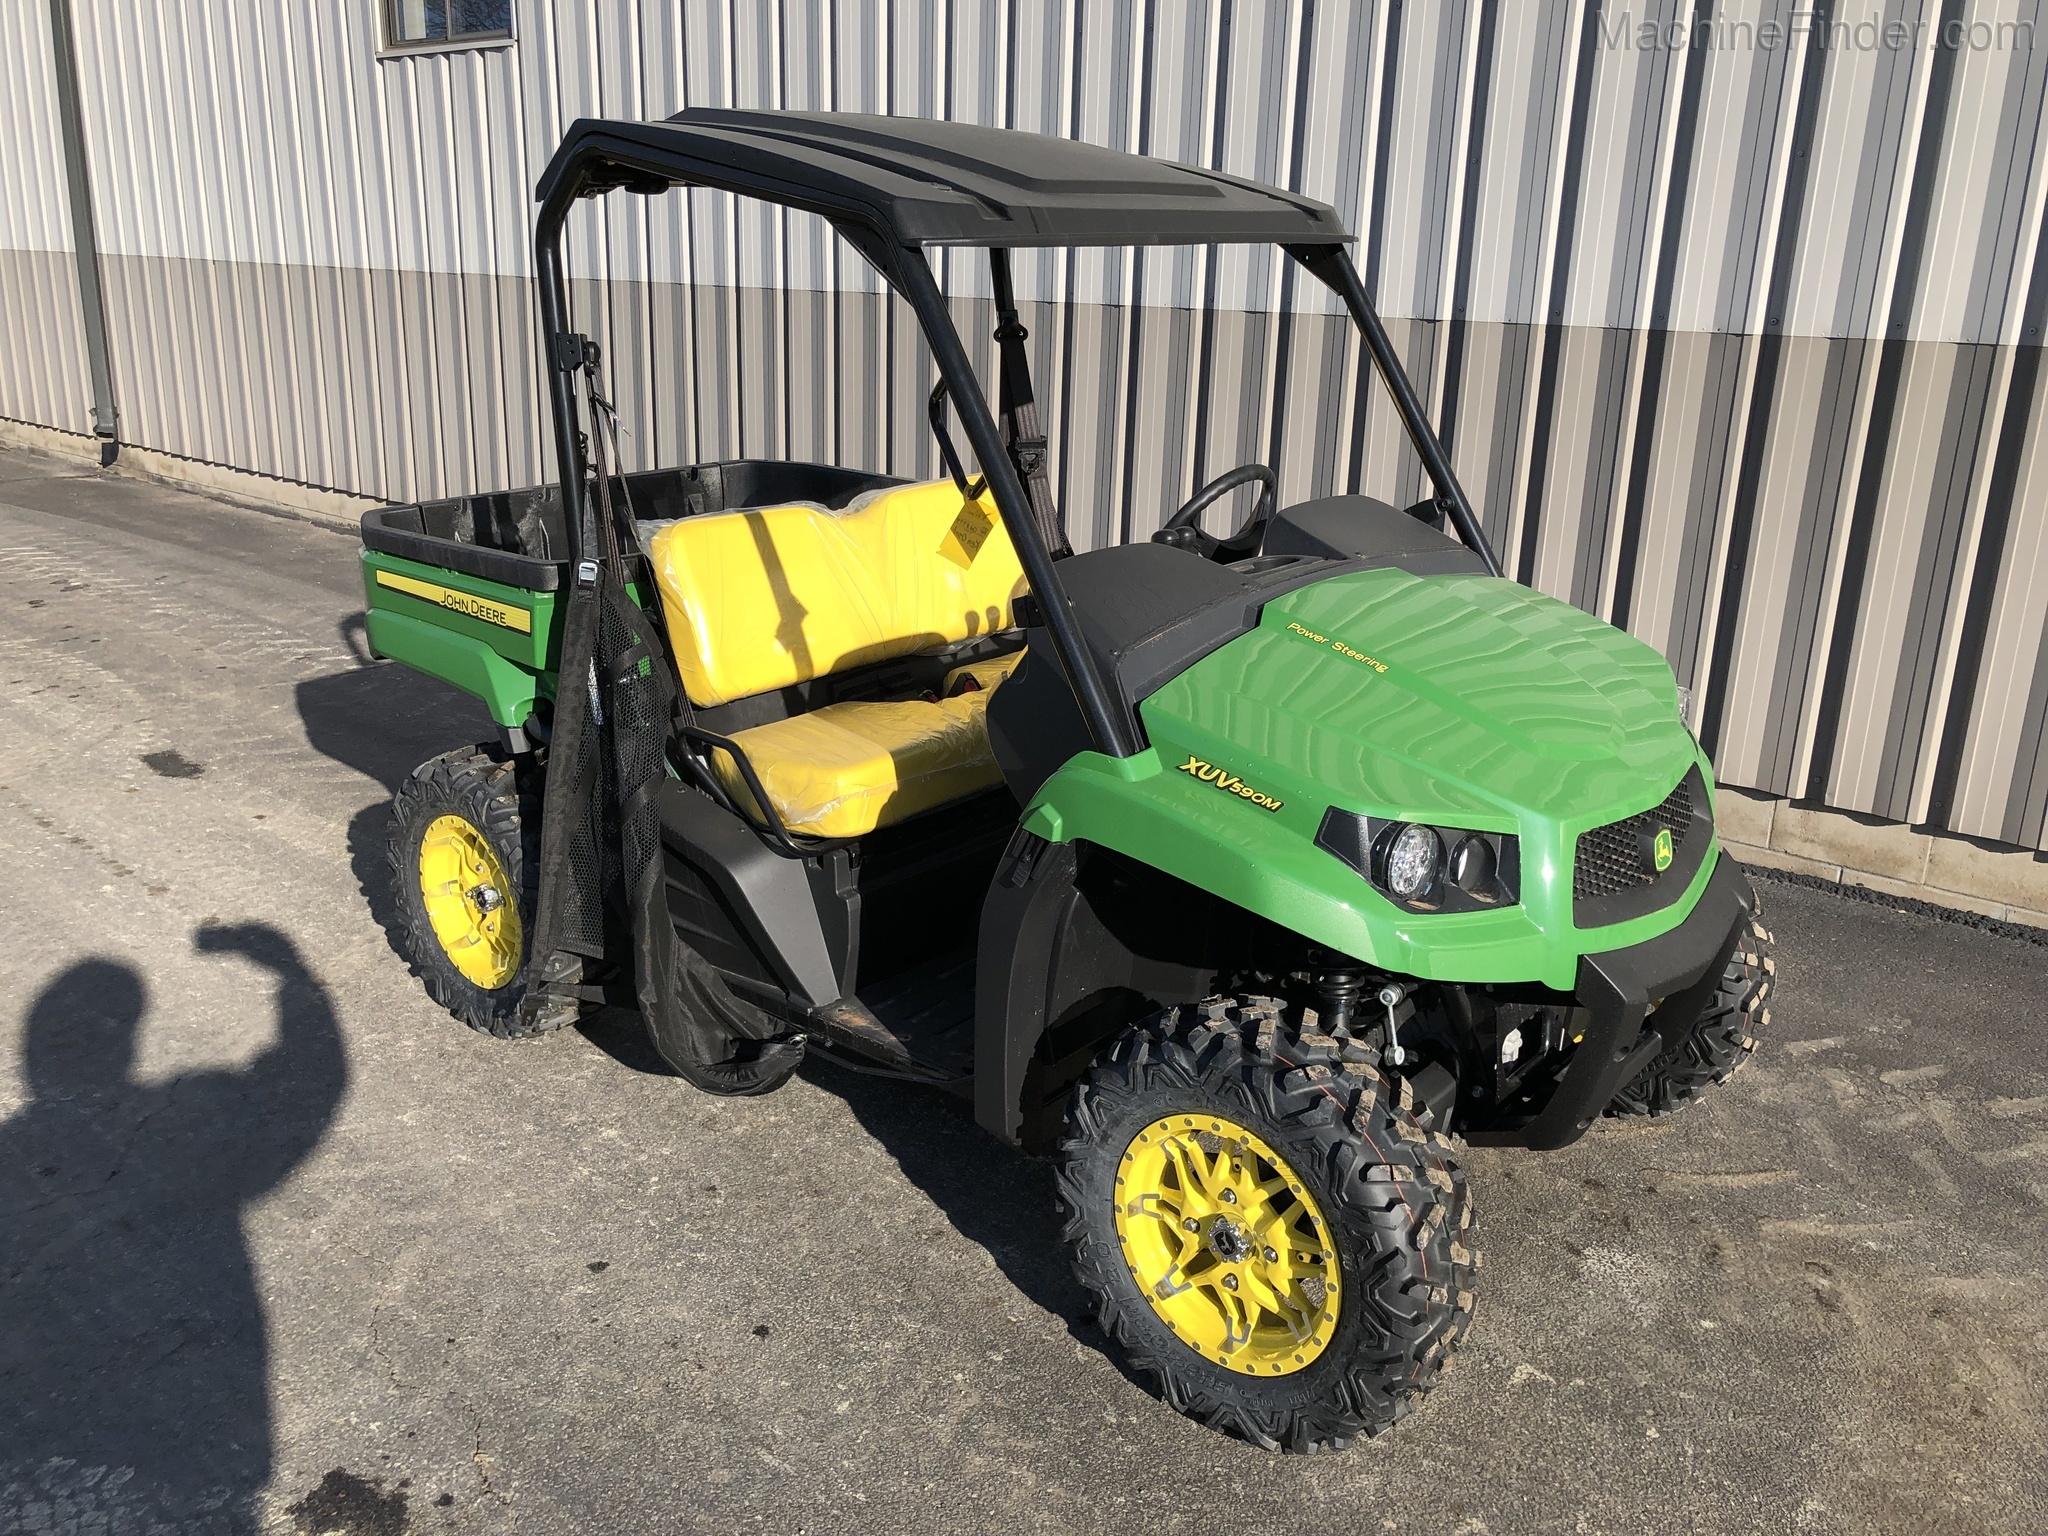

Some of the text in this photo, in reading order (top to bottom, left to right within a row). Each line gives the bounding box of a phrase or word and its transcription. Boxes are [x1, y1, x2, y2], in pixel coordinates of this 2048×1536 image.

[440, 590, 507, 625] JOHN DEERE
[1286, 622, 1390, 673] Power Steering
[1177, 754, 1284, 812] XUV590M
